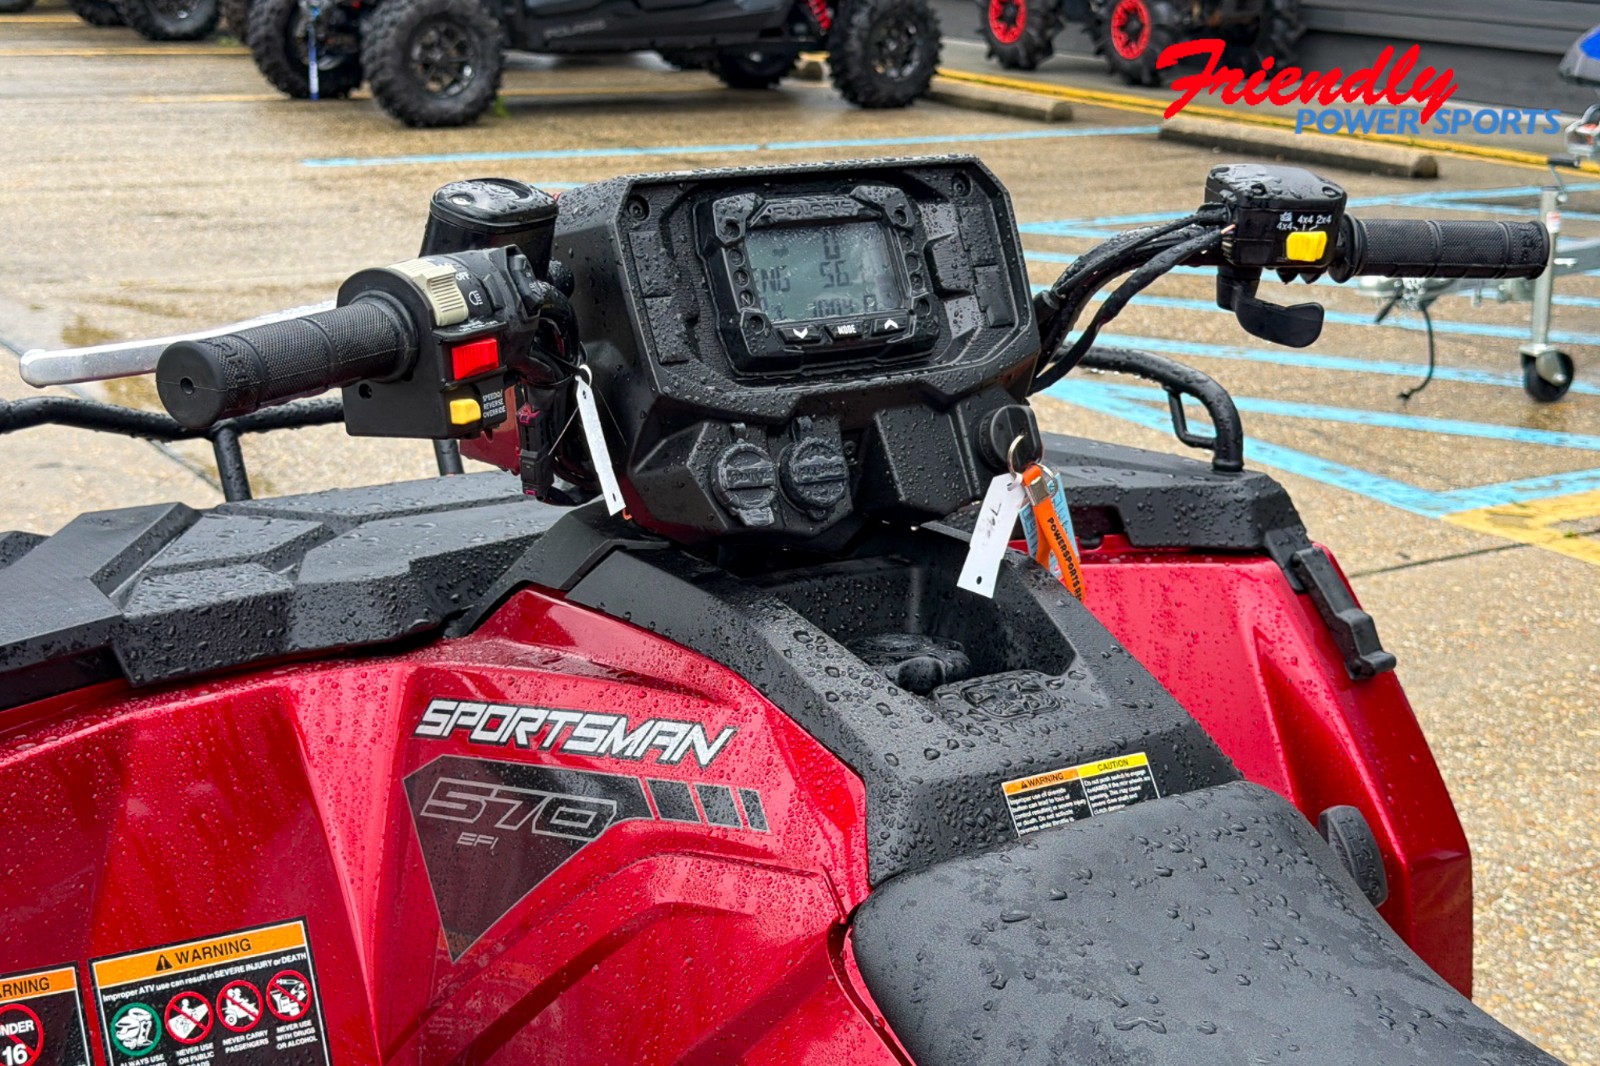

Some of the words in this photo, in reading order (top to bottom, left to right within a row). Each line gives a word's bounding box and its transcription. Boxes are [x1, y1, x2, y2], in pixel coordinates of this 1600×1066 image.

[837, 324, 857, 335] MODE
[483, 398, 504, 410] REVERSE
[483, 405, 506, 418] OVERRIDE
[1047, 517, 1080, 588] POWERSPORTS
[413, 698, 738, 769] SPORTSMAN
[1098, 759, 1129, 771] CAUTION
[1028, 773, 1064, 786] WARNING
[420, 777, 618, 842] 570
[456, 832, 499, 850] EFI
[175, 938, 252, 965] WARNING
[103, 988, 138, 1002] Improper
[139, 984, 156, 995] ATV
[156, 983, 170, 992] use
[170, 979, 184, 988] can
[185, 973, 207, 984] result
[207, 971, 215, 980] in
[213, 964, 245, 979] SEVERE
[245, 959, 273, 972] INJURY
[273, 958, 282, 967] or
[281, 951, 307, 965] DEATH
[0, 1019, 35, 1036] NDER
[276, 1022, 298, 1033] NEVER
[299, 1019, 312, 1028] USE
[222, 1034, 245, 1046] NEVER
[246, 1029, 268, 1041] CARRY
[276, 1031, 293, 1042] WITH
[293, 1027, 316, 1037] DRUGS
[175, 1045, 199, 1057] NEVER
[200, 1042, 214, 1051] USE
[225, 1037, 269, 1053] PASSENGERS
[276, 1042, 287, 1050] OR
[288, 1035, 318, 1048] ALCOHOL
[2, 1043, 28, 1066] 16
[150, 1053, 165, 1062] USE
[178, 1056, 190, 1065] ON
[190, 1050, 215, 1062] PUBLIC
